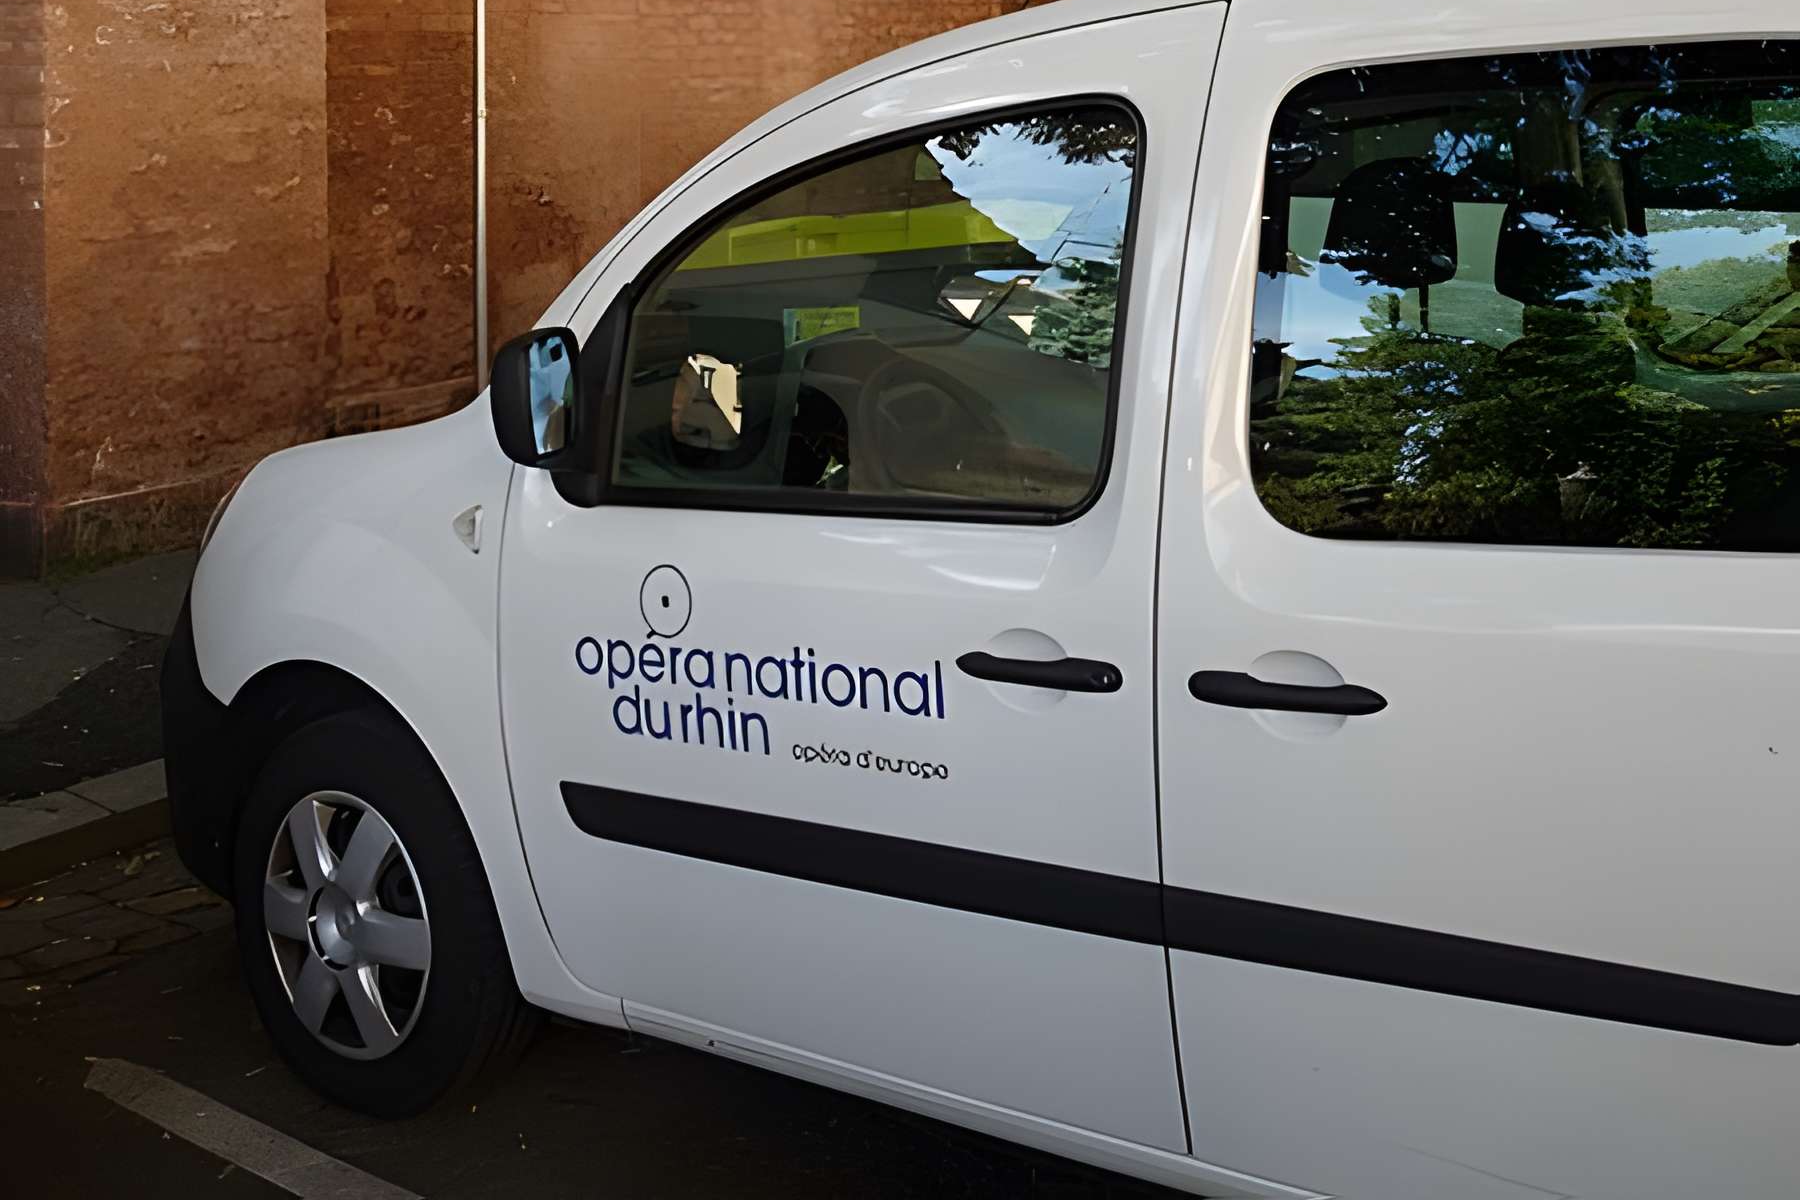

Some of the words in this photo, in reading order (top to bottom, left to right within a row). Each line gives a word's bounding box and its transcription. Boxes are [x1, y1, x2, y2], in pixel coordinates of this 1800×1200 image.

[724, 646, 945, 719] national
[612, 684, 673, 740] du
[679, 692, 771, 755] rhin
